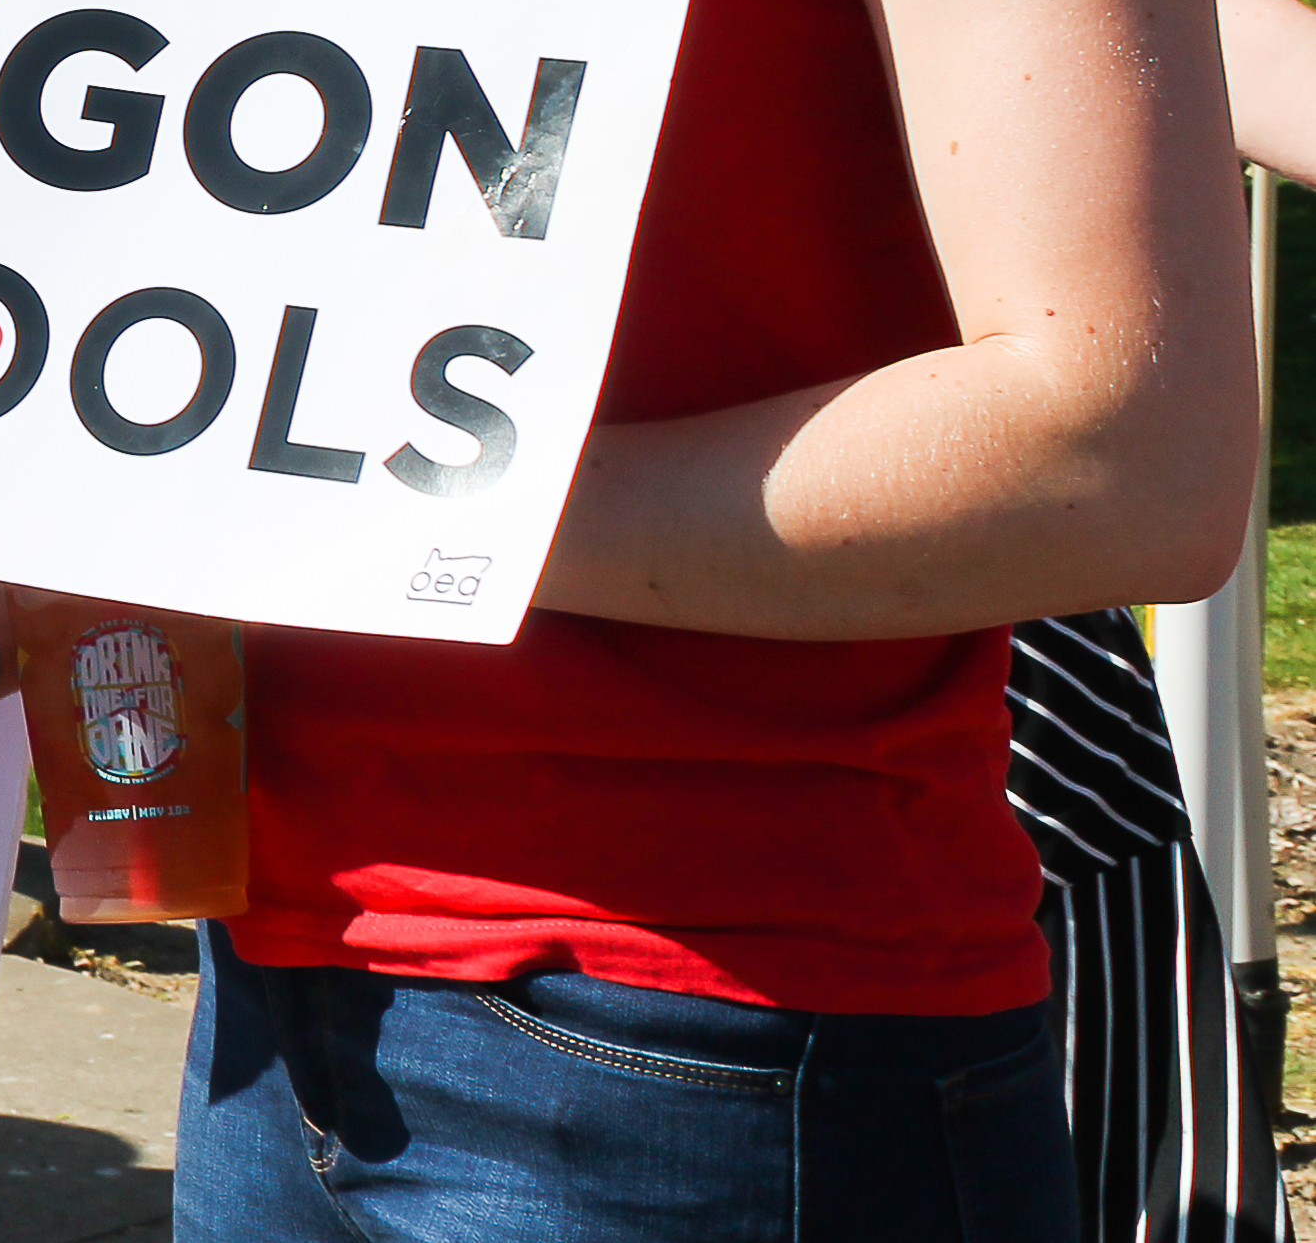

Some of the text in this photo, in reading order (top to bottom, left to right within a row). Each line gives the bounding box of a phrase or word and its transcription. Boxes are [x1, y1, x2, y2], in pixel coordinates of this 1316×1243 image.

[410, 571, 481, 596] oea
[80, 632, 170, 688] DRINK
[88, 809, 130, 822] FRIDAY
[139, 806, 165, 818] MAY
